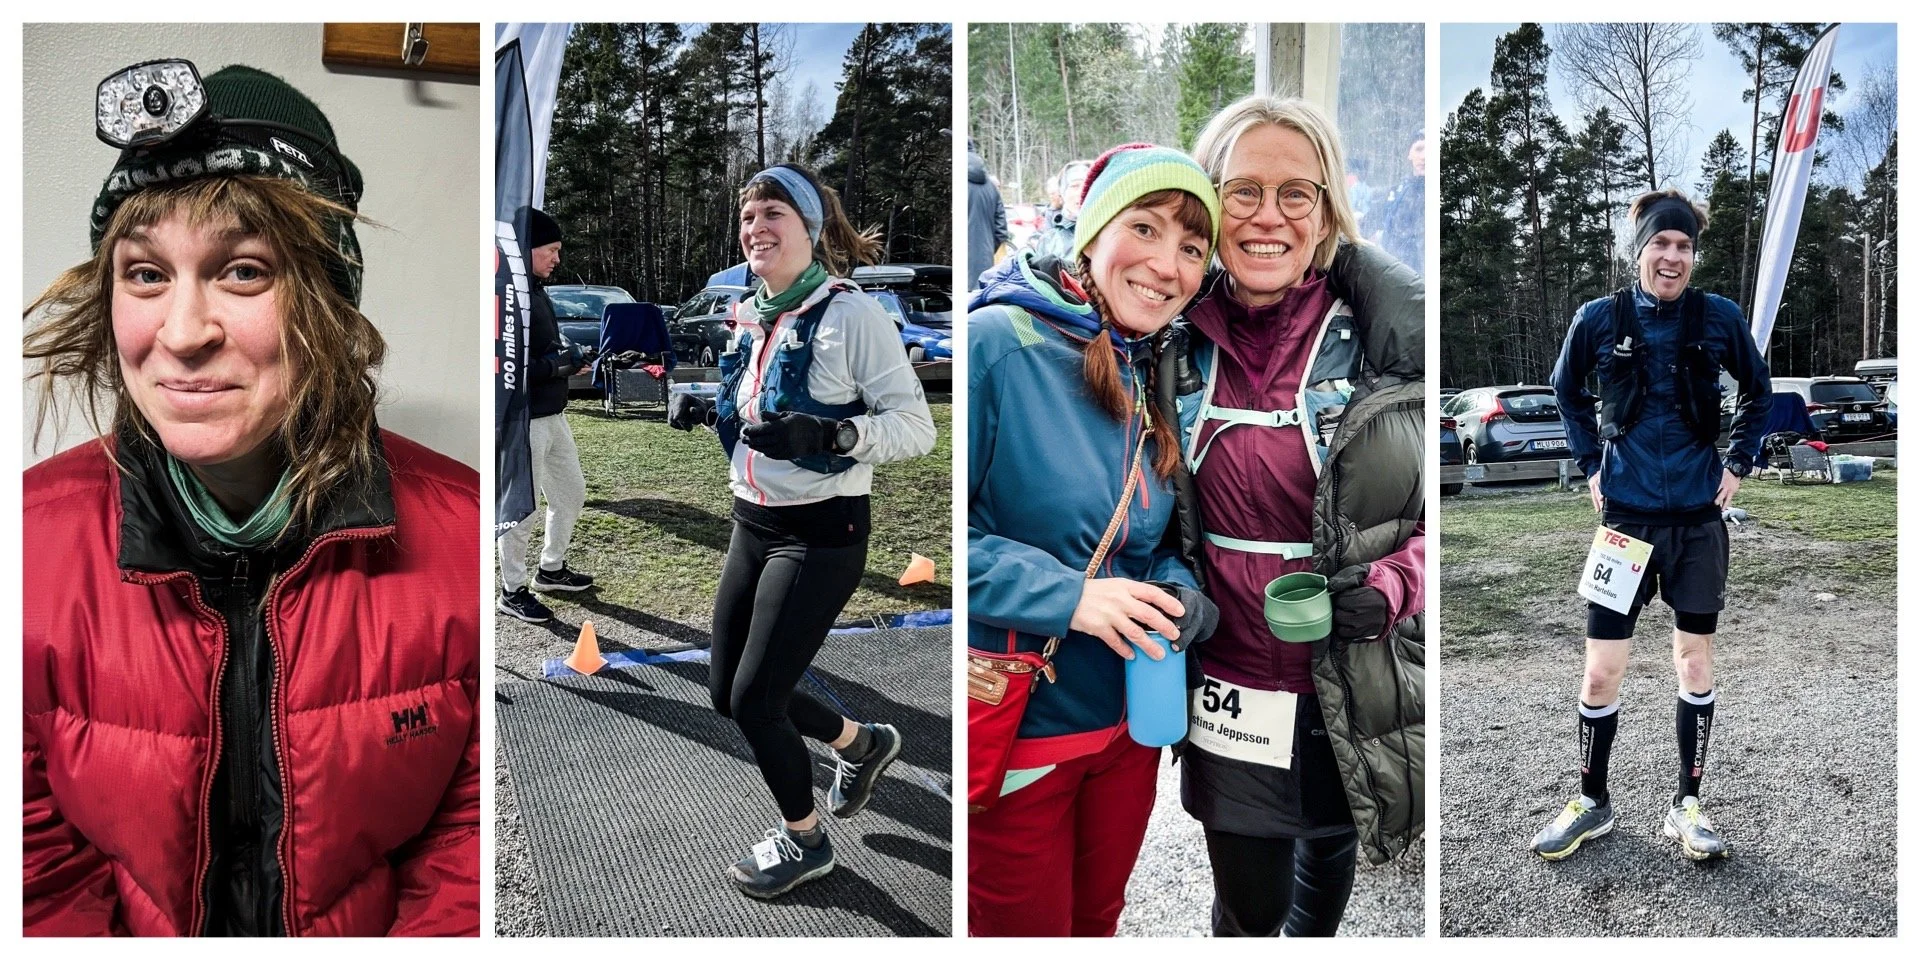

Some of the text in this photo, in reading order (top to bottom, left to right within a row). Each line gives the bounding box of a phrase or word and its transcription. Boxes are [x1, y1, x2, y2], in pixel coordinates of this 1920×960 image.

[1784, 86, 1823, 153] U
[272, 138, 314, 168] PETZL
[502, 283, 516, 390] 100 miles run
[1604, 531, 1630, 548] TEC
[1593, 563, 1613, 585] 64
[1202, 678, 1242, 720] 54
[391, 705, 427, 733] HH
[1192, 714, 1270, 746] stina Jeppsson
